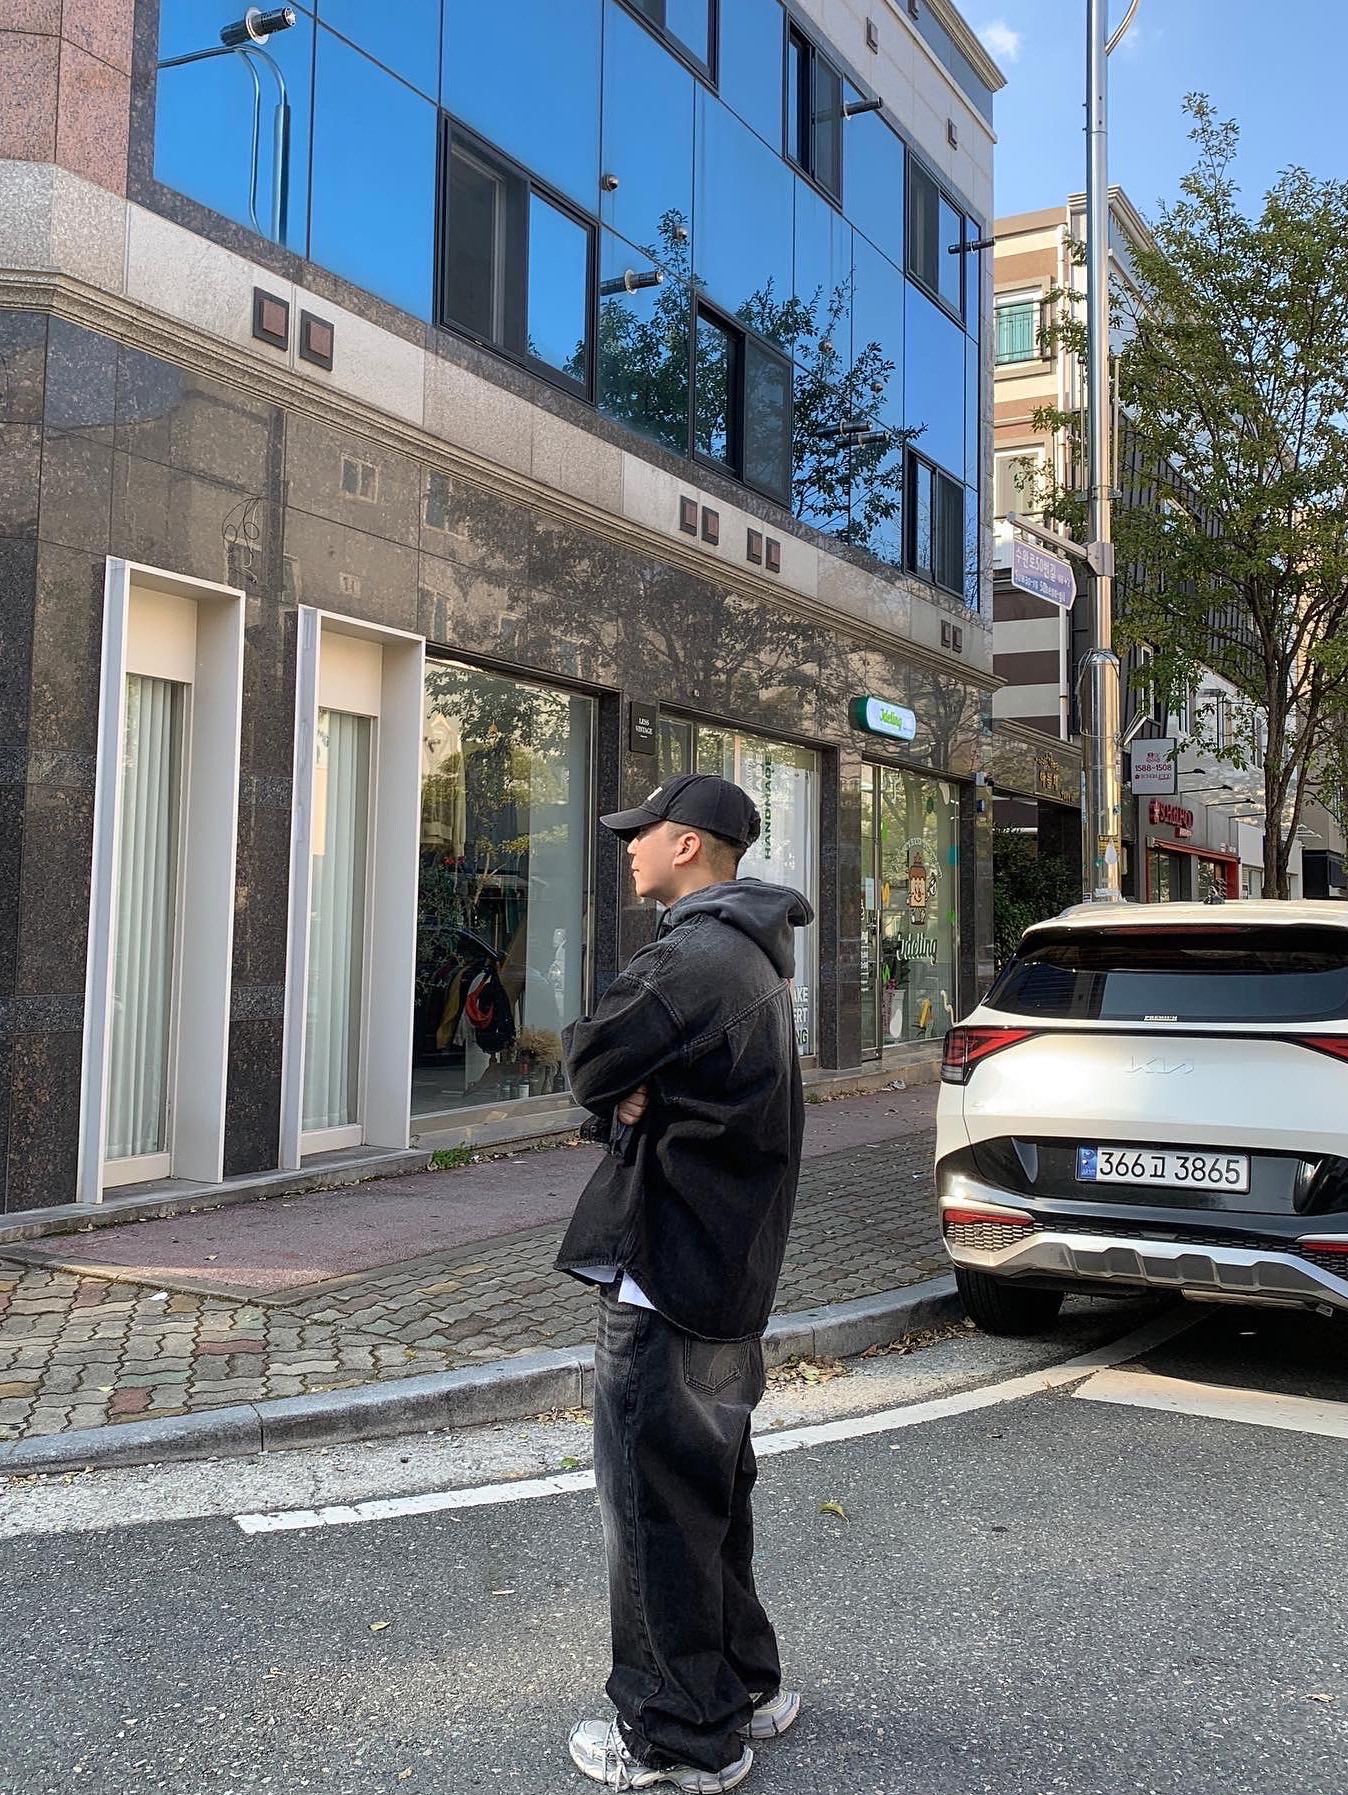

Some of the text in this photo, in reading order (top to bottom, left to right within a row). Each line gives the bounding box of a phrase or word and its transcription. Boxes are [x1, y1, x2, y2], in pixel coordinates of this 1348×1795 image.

[764, 754, 772, 859] HANDMADE
[1099, 1152, 1240, 1185] 366고 3865
